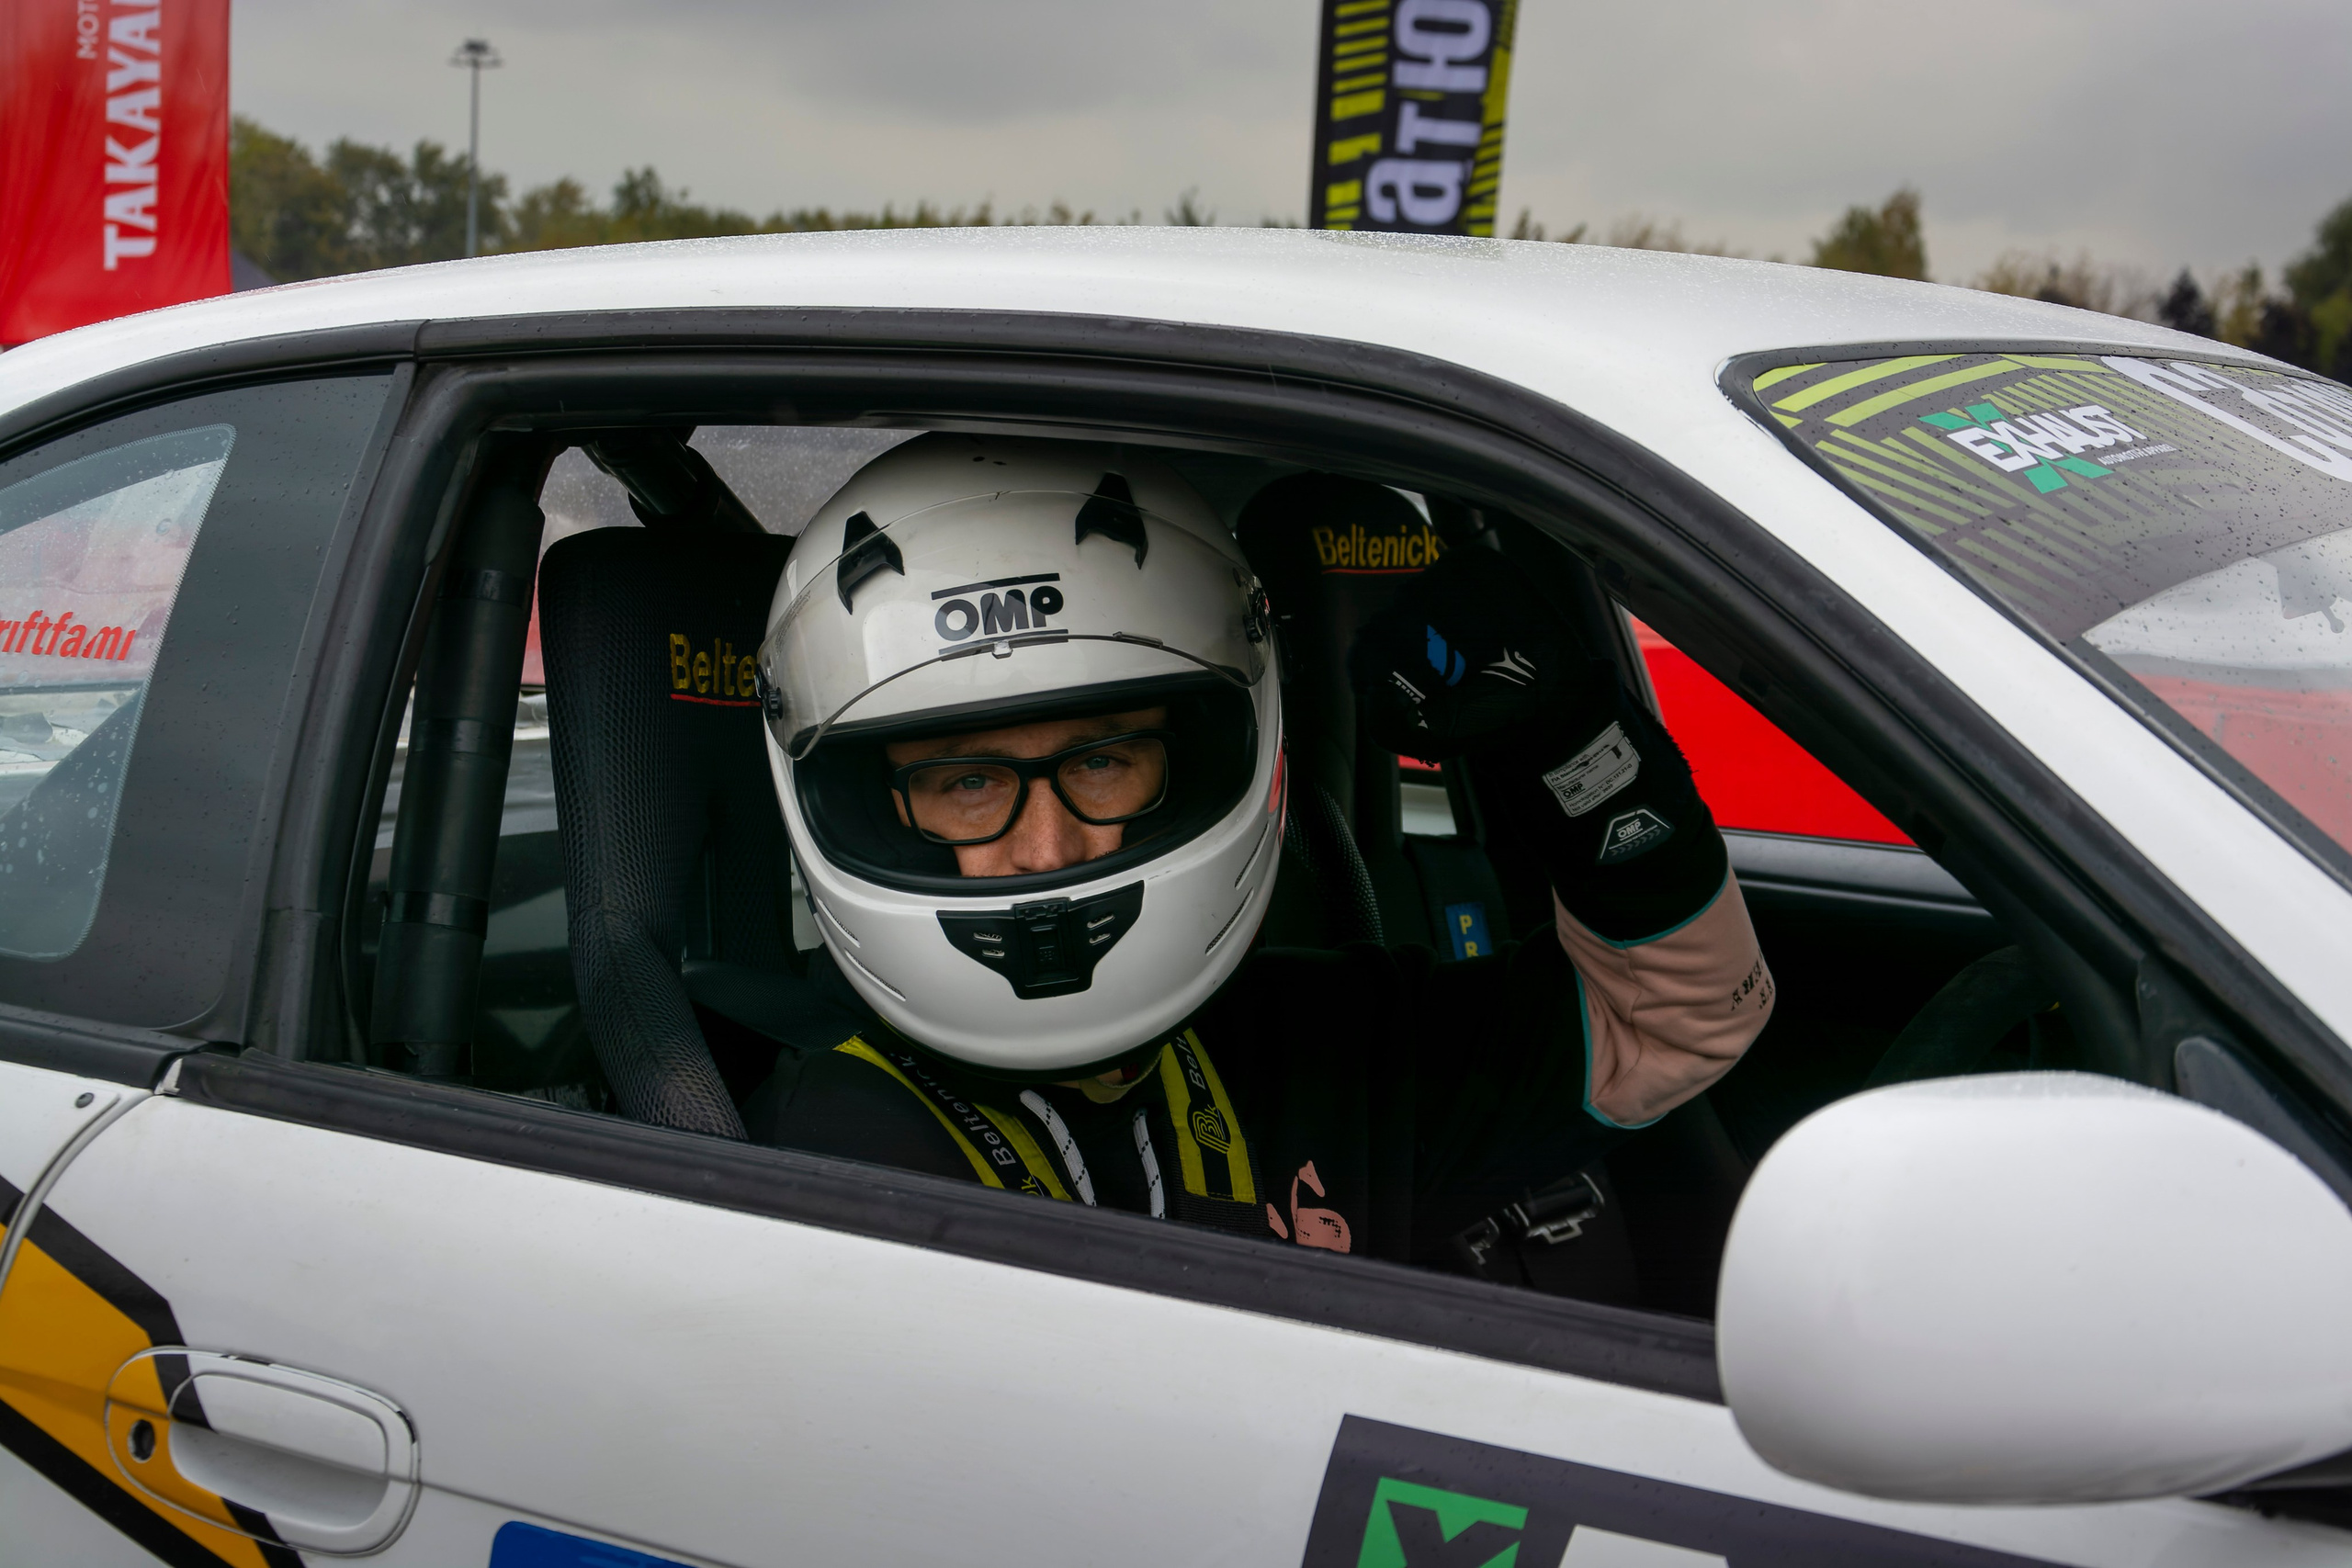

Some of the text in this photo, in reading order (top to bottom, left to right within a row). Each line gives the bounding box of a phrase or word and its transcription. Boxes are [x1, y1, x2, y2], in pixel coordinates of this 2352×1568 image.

[104, 0, 161, 271] TAKAYA
[1946, 404, 2147, 472] EXHAUST
[1313, 523, 1440, 568] Beltenick
[934, 585, 1064, 642] OMP
[670, 633, 757, 697] Belte
[1563, 783, 1584, 798] OMP
[1617, 820, 1642, 839] OMP
